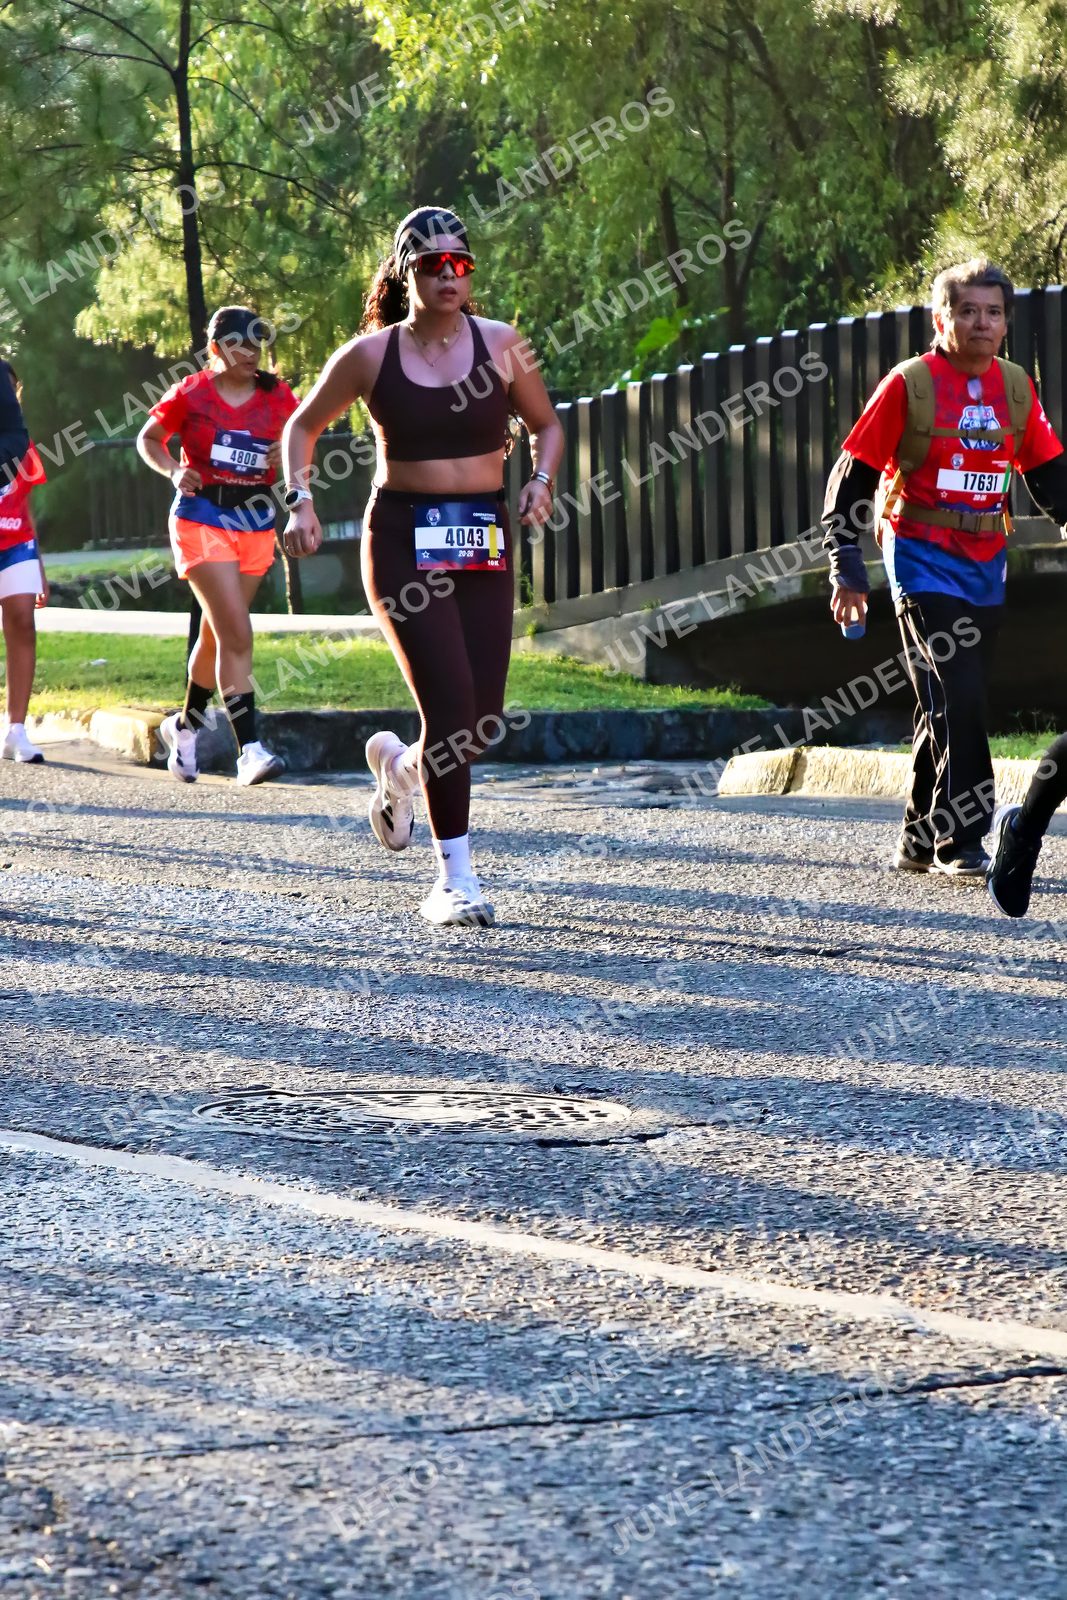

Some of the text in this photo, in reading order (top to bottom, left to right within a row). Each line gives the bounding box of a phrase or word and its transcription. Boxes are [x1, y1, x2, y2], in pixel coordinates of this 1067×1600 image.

[230, 449, 258, 466] 4808
[963, 473, 998, 491] 17631
[445, 528, 484, 547] 4043
